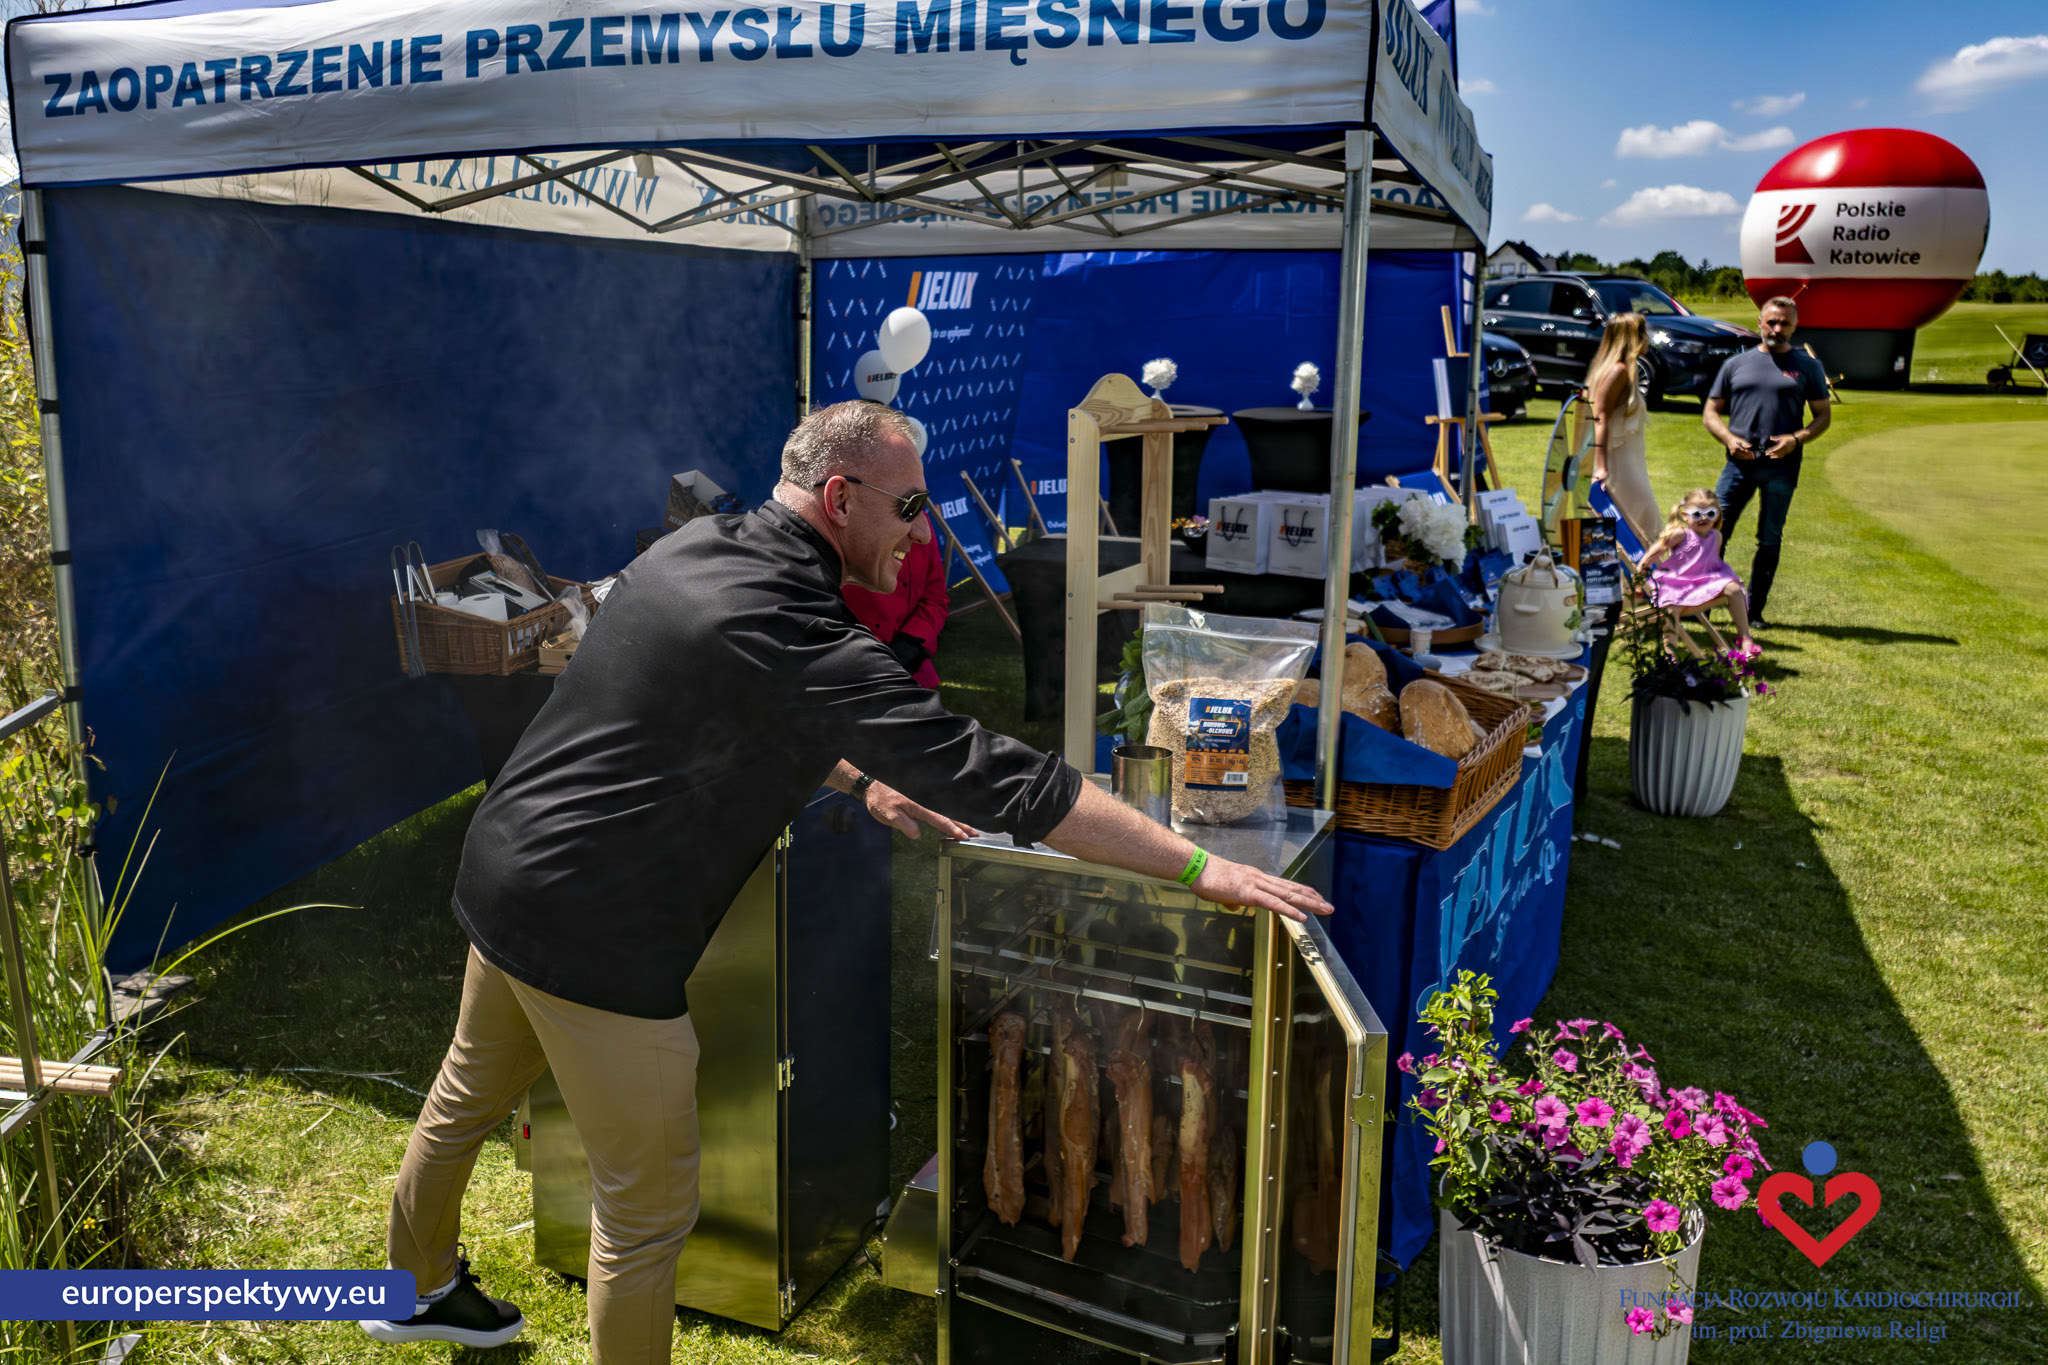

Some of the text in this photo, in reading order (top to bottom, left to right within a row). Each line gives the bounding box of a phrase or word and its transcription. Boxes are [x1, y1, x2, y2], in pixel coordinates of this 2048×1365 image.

[44, 0, 1327, 118] ZAOPATRZENIE PRZEMYSŁU MIĘSNEGO
[1836, 201, 1906, 217] Polskie
[1832, 224, 1890, 241] Radio
[1829, 248, 1921, 265] Katowice
[917, 271, 979, 311] JELUX
[1038, 480, 1068, 495] JELU
[942, 497, 969, 519] JELUX
[1210, 706, 1234, 715] JELUX
